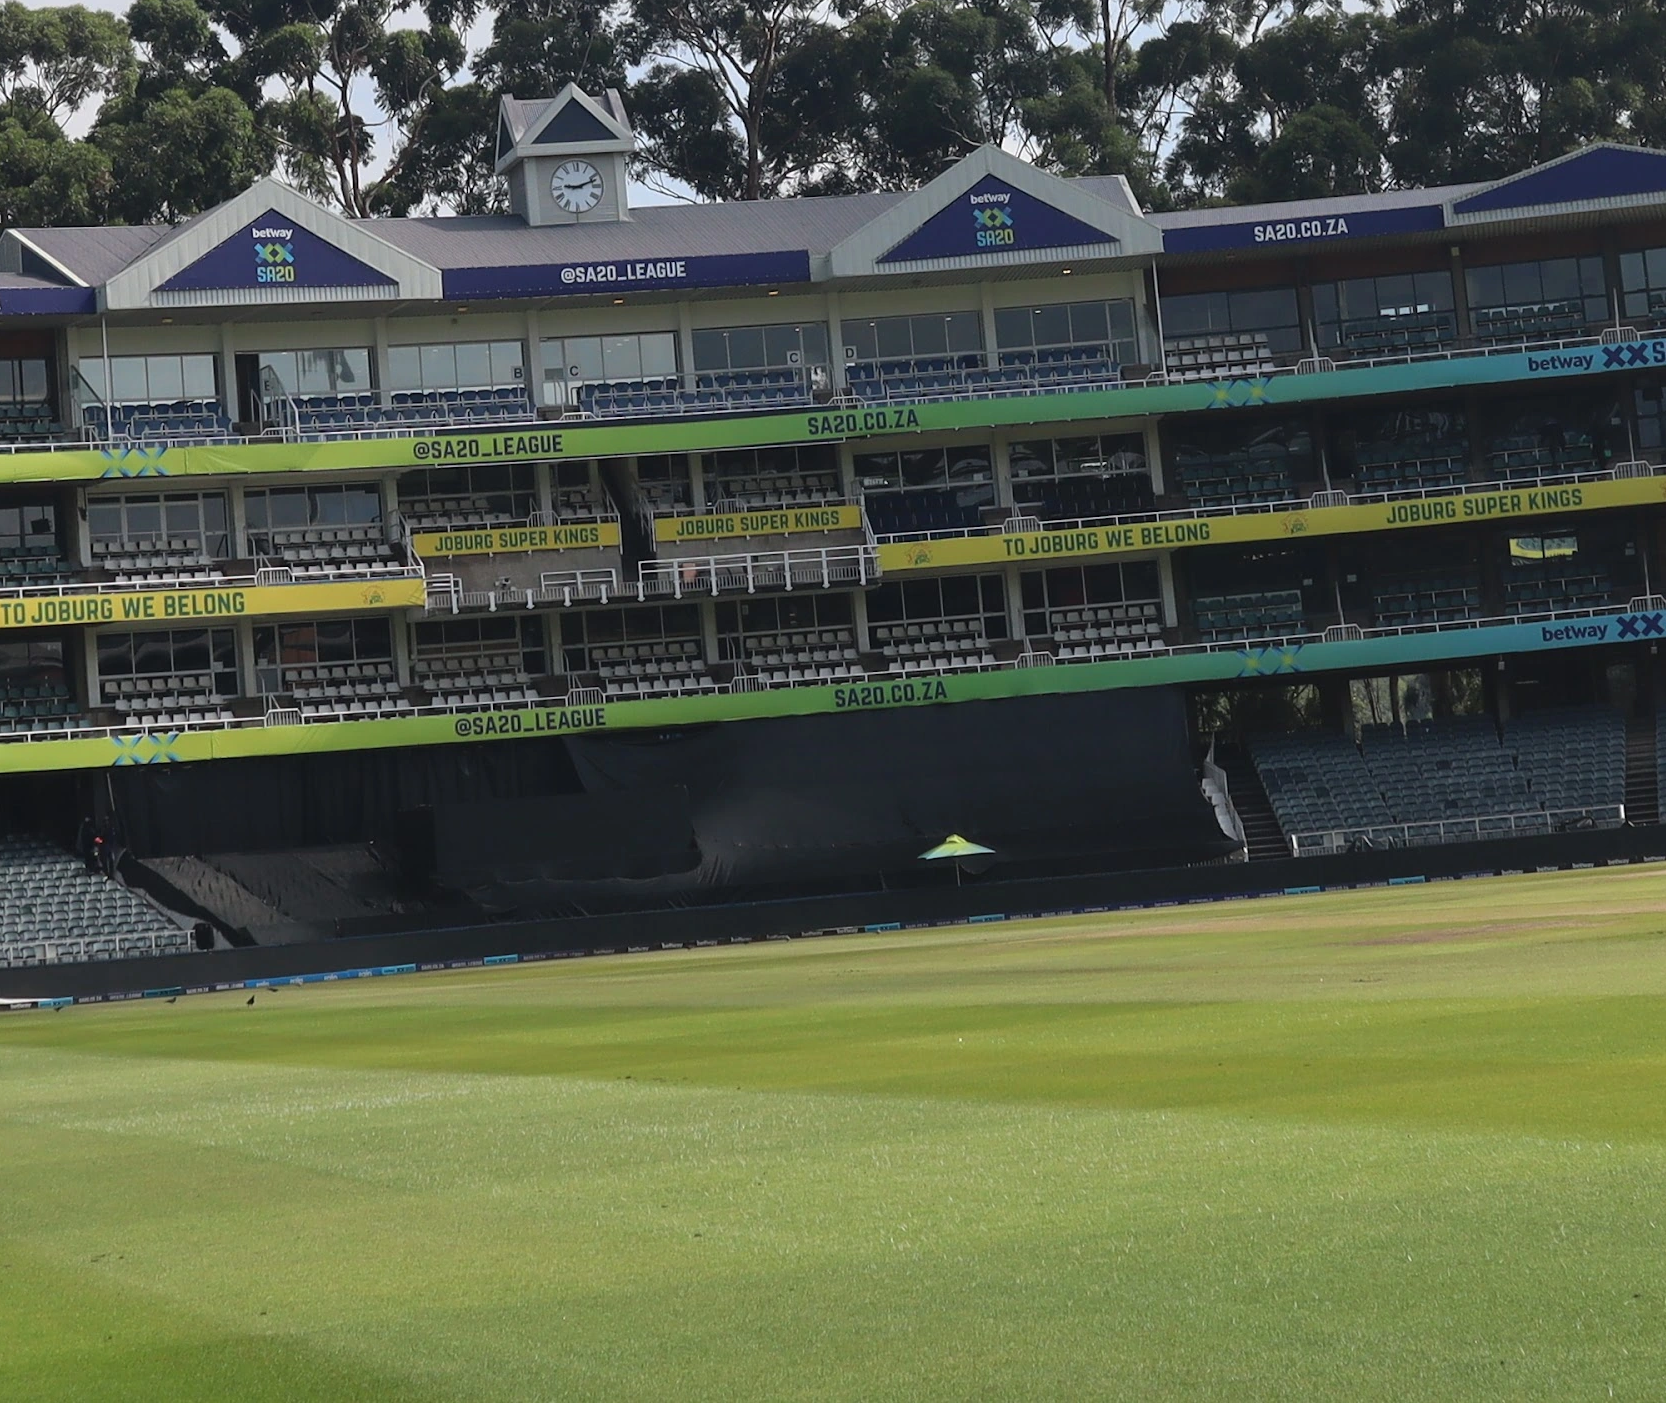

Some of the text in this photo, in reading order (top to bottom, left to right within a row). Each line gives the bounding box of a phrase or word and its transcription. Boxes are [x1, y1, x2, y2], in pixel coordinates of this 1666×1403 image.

[970, 193, 1011, 204] betway
[252, 228, 293, 240] betway
[976, 229, 1014, 247] SA20
[1254, 218, 1348, 242] SA20.CO.ZA
[257, 266, 294, 282] SA20
[561, 261, 686, 283] @SA20_LEAGUE
[1528, 355, 1594, 372] betway
[808, 409, 920, 435] SA20.CO.ZA
[413, 434, 563, 460] @SA20_LEAGUE
[1386, 488, 1582, 524] JOBURG SUPER KINGS
[676, 510, 839, 536] JOBURG SUPER KINGS
[435, 527, 599, 552] JOBURG SUPER KINGS
[1003, 523, 1210, 556] TO JOBURG WE BELONG
[0, 592, 245, 625] TO JOBURG WE BELONG
[1542, 620, 1608, 643] betway
[835, 681, 948, 708] SA20.CO.ZA
[455, 704, 606, 737] @SA20_LEAGUE
